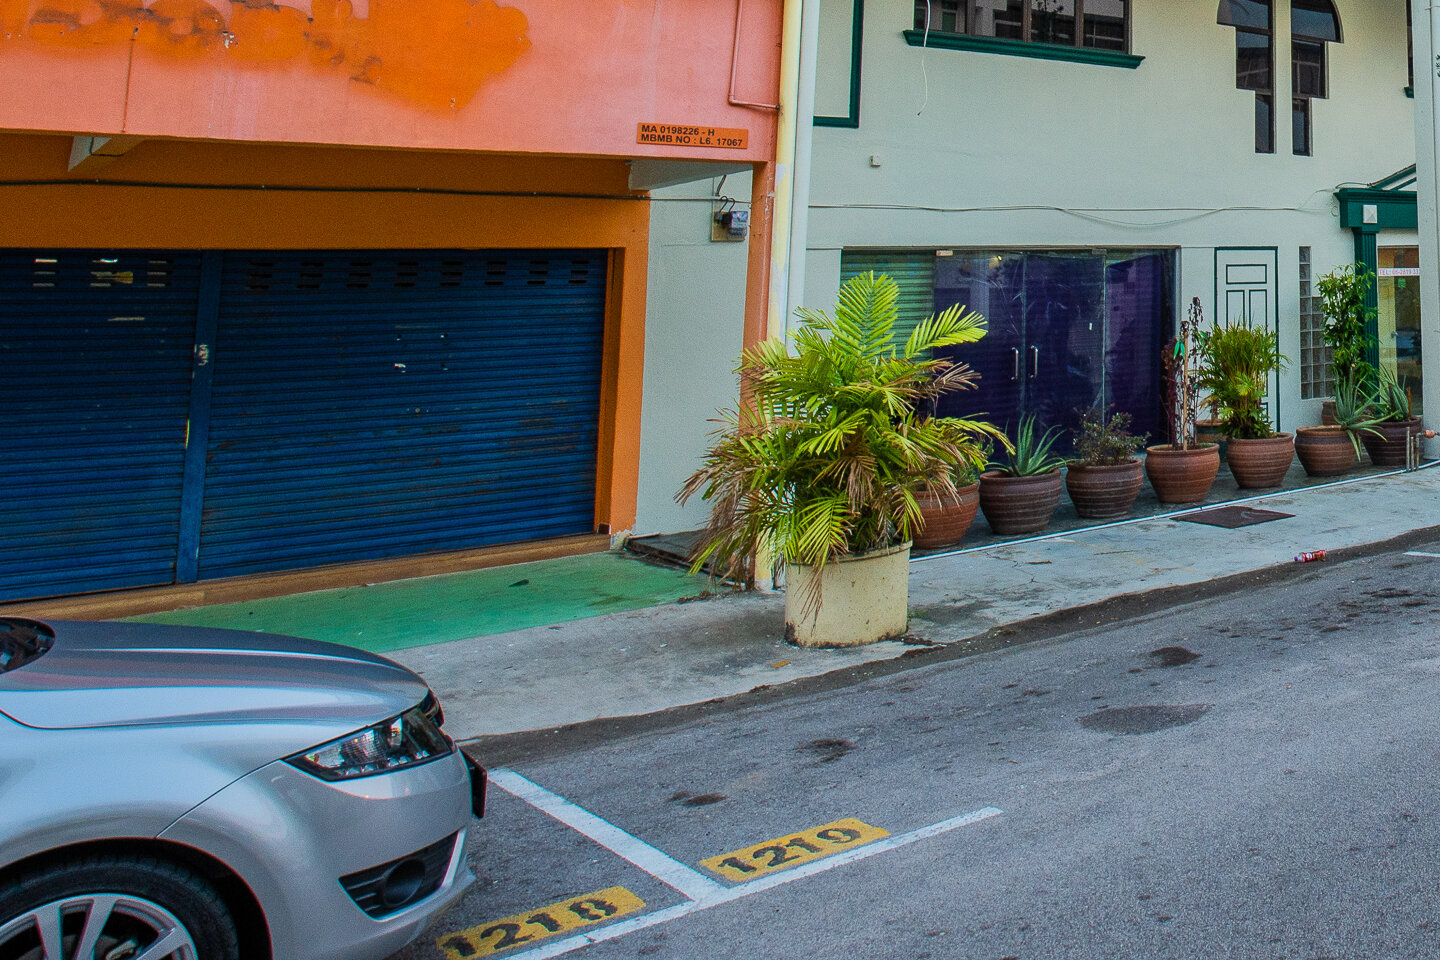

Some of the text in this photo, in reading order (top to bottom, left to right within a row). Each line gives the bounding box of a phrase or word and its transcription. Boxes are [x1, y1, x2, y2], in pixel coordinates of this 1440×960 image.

[641, 124, 657, 134] MA
[660, 126, 700, 136] 0198226
[640, 134, 673, 144] MBMB
[676, 136, 691, 144] NO
[716, 138, 742, 147] 17067
[717, 825, 864, 875] 1219
